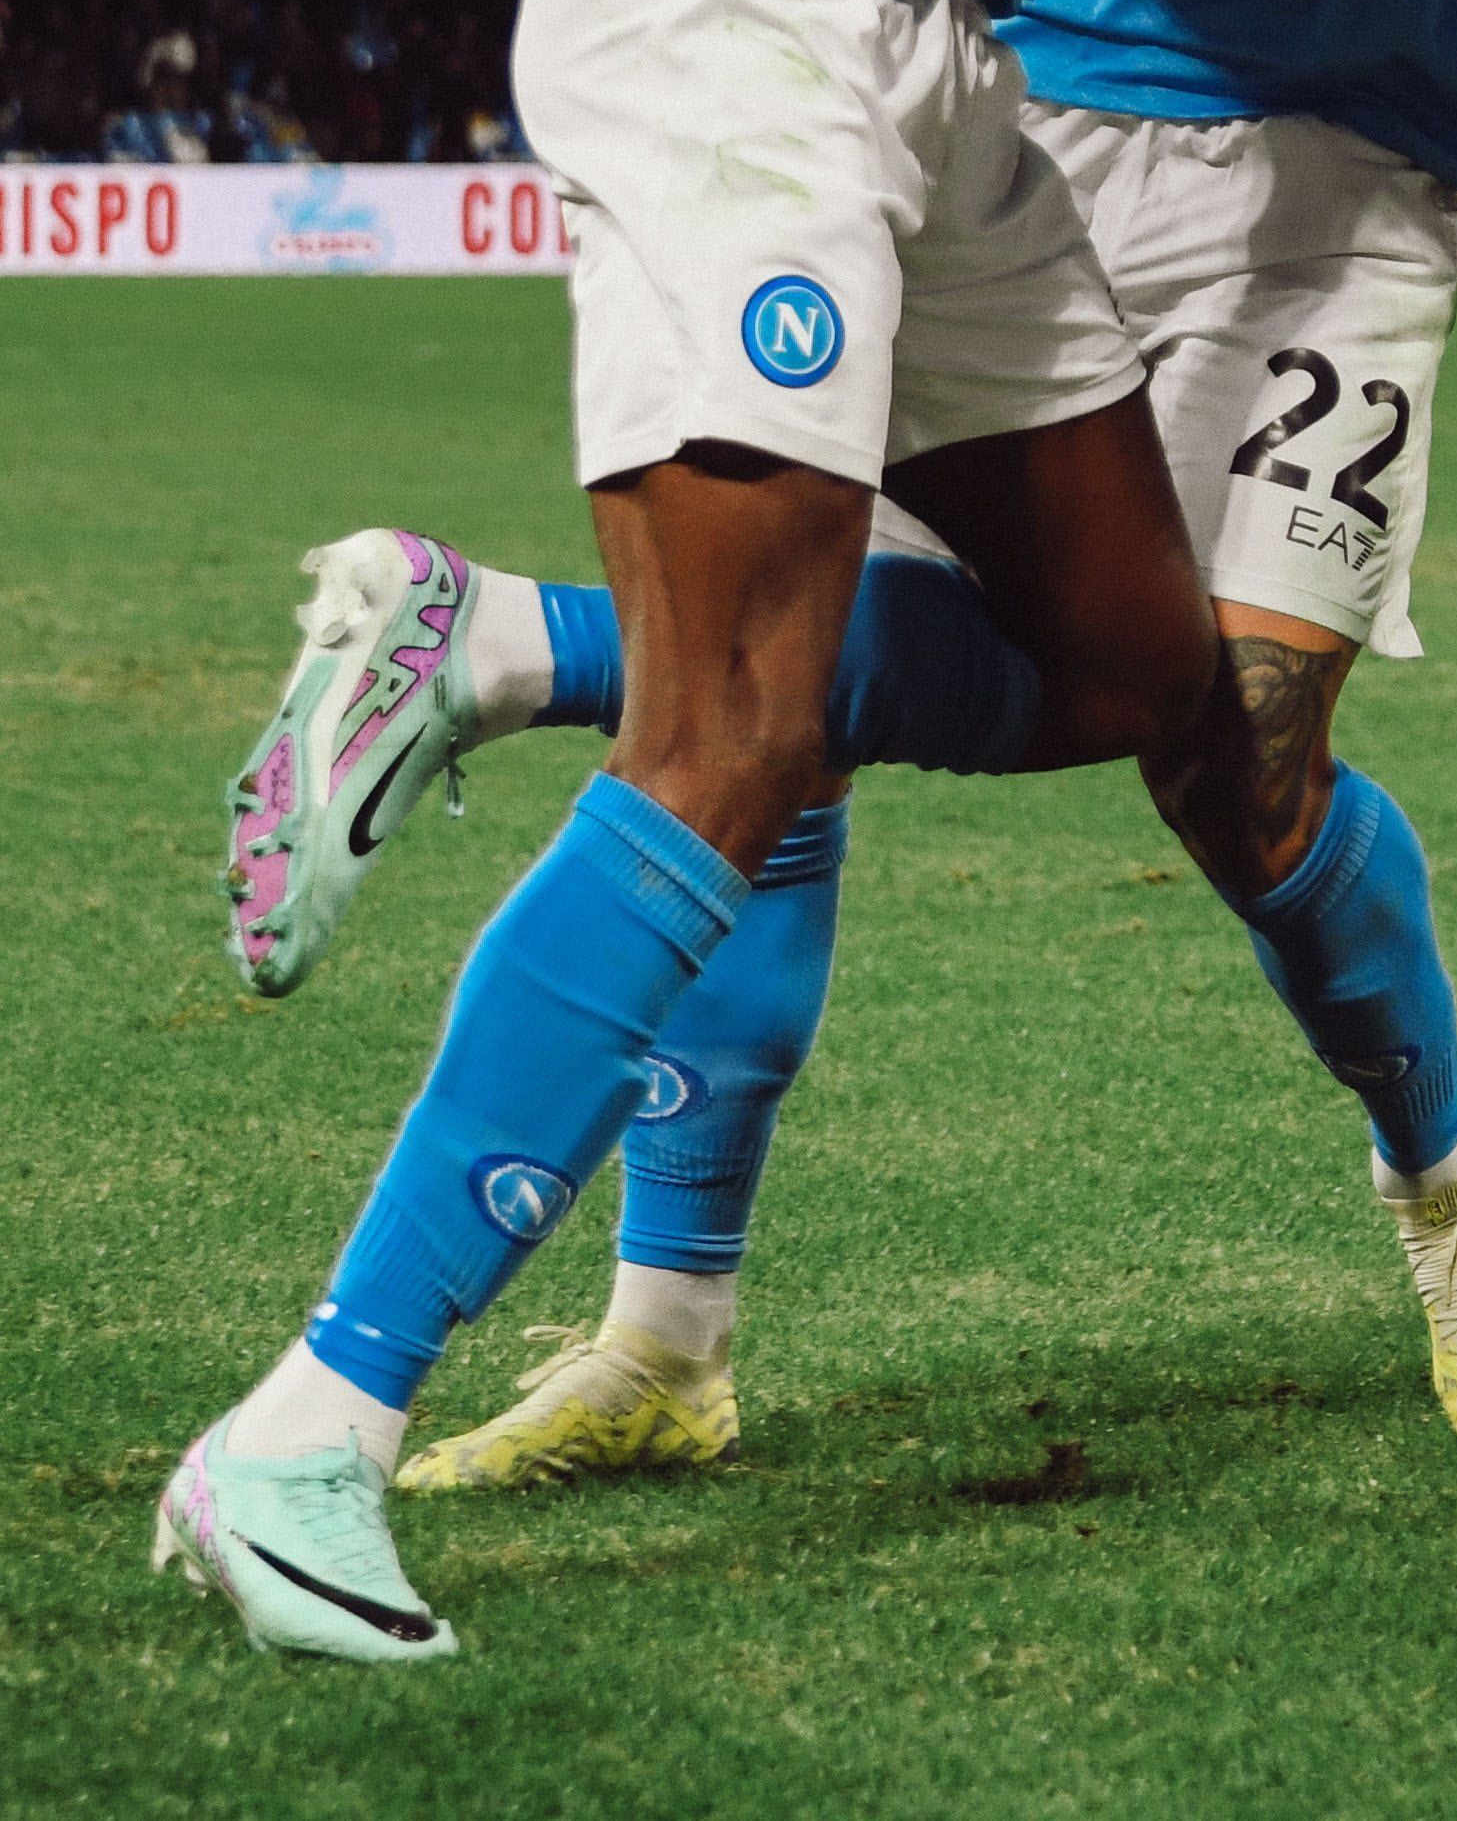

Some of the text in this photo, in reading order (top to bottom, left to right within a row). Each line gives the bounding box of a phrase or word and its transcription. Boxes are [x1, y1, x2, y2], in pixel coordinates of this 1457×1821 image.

[0, 181, 179, 257] ISPO
[771, 301, 820, 358] N
[1228, 347, 1410, 532] 22
[1285, 504, 1377, 572] EA7
